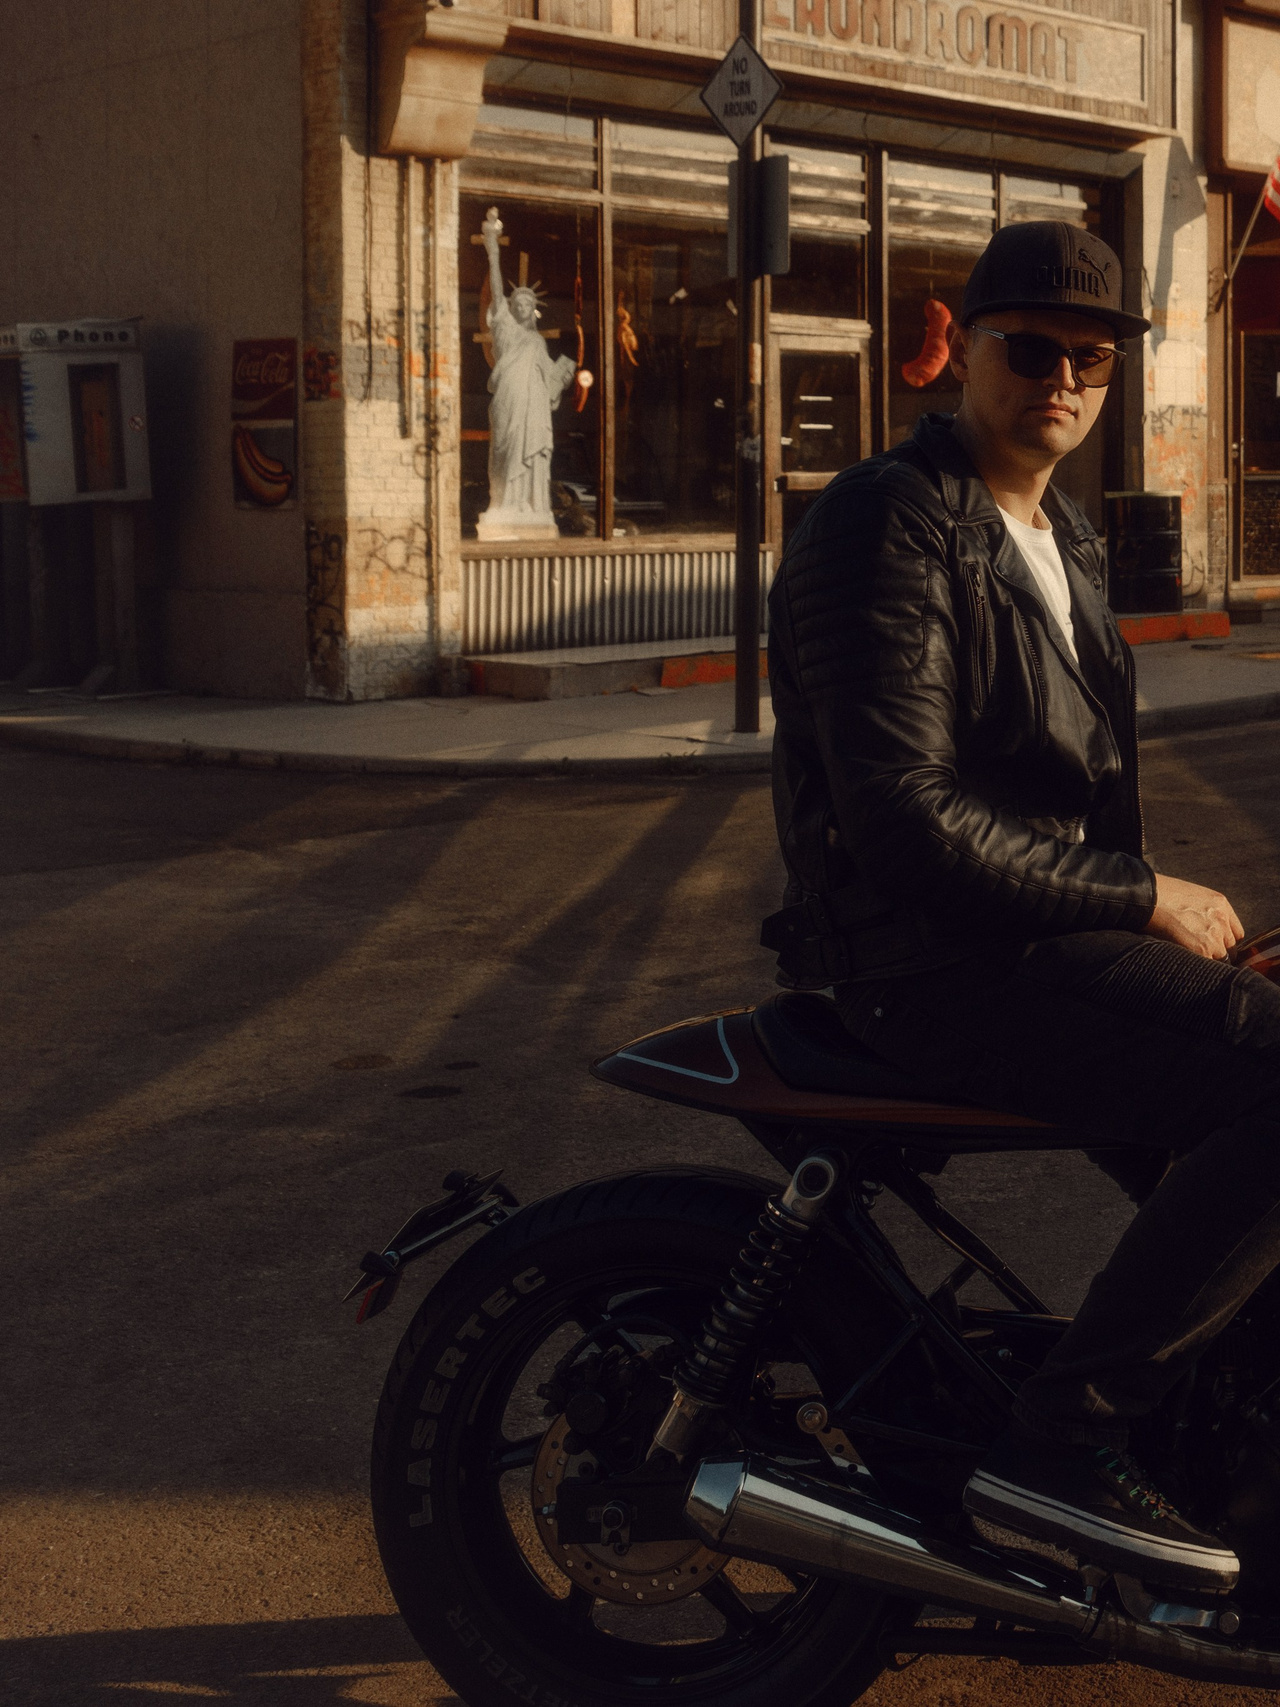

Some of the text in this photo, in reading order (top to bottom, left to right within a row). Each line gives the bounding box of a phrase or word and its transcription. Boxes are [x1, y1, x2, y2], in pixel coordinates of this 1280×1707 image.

[733, 57, 748, 75] NO
[729, 80, 751, 97] TURN
[723, 100, 757, 117] AROUND
[1037, 265, 1100, 298] PUMA
[57, 328, 129, 343] Phone
[407, 1266, 546, 1527] LASERTEC
